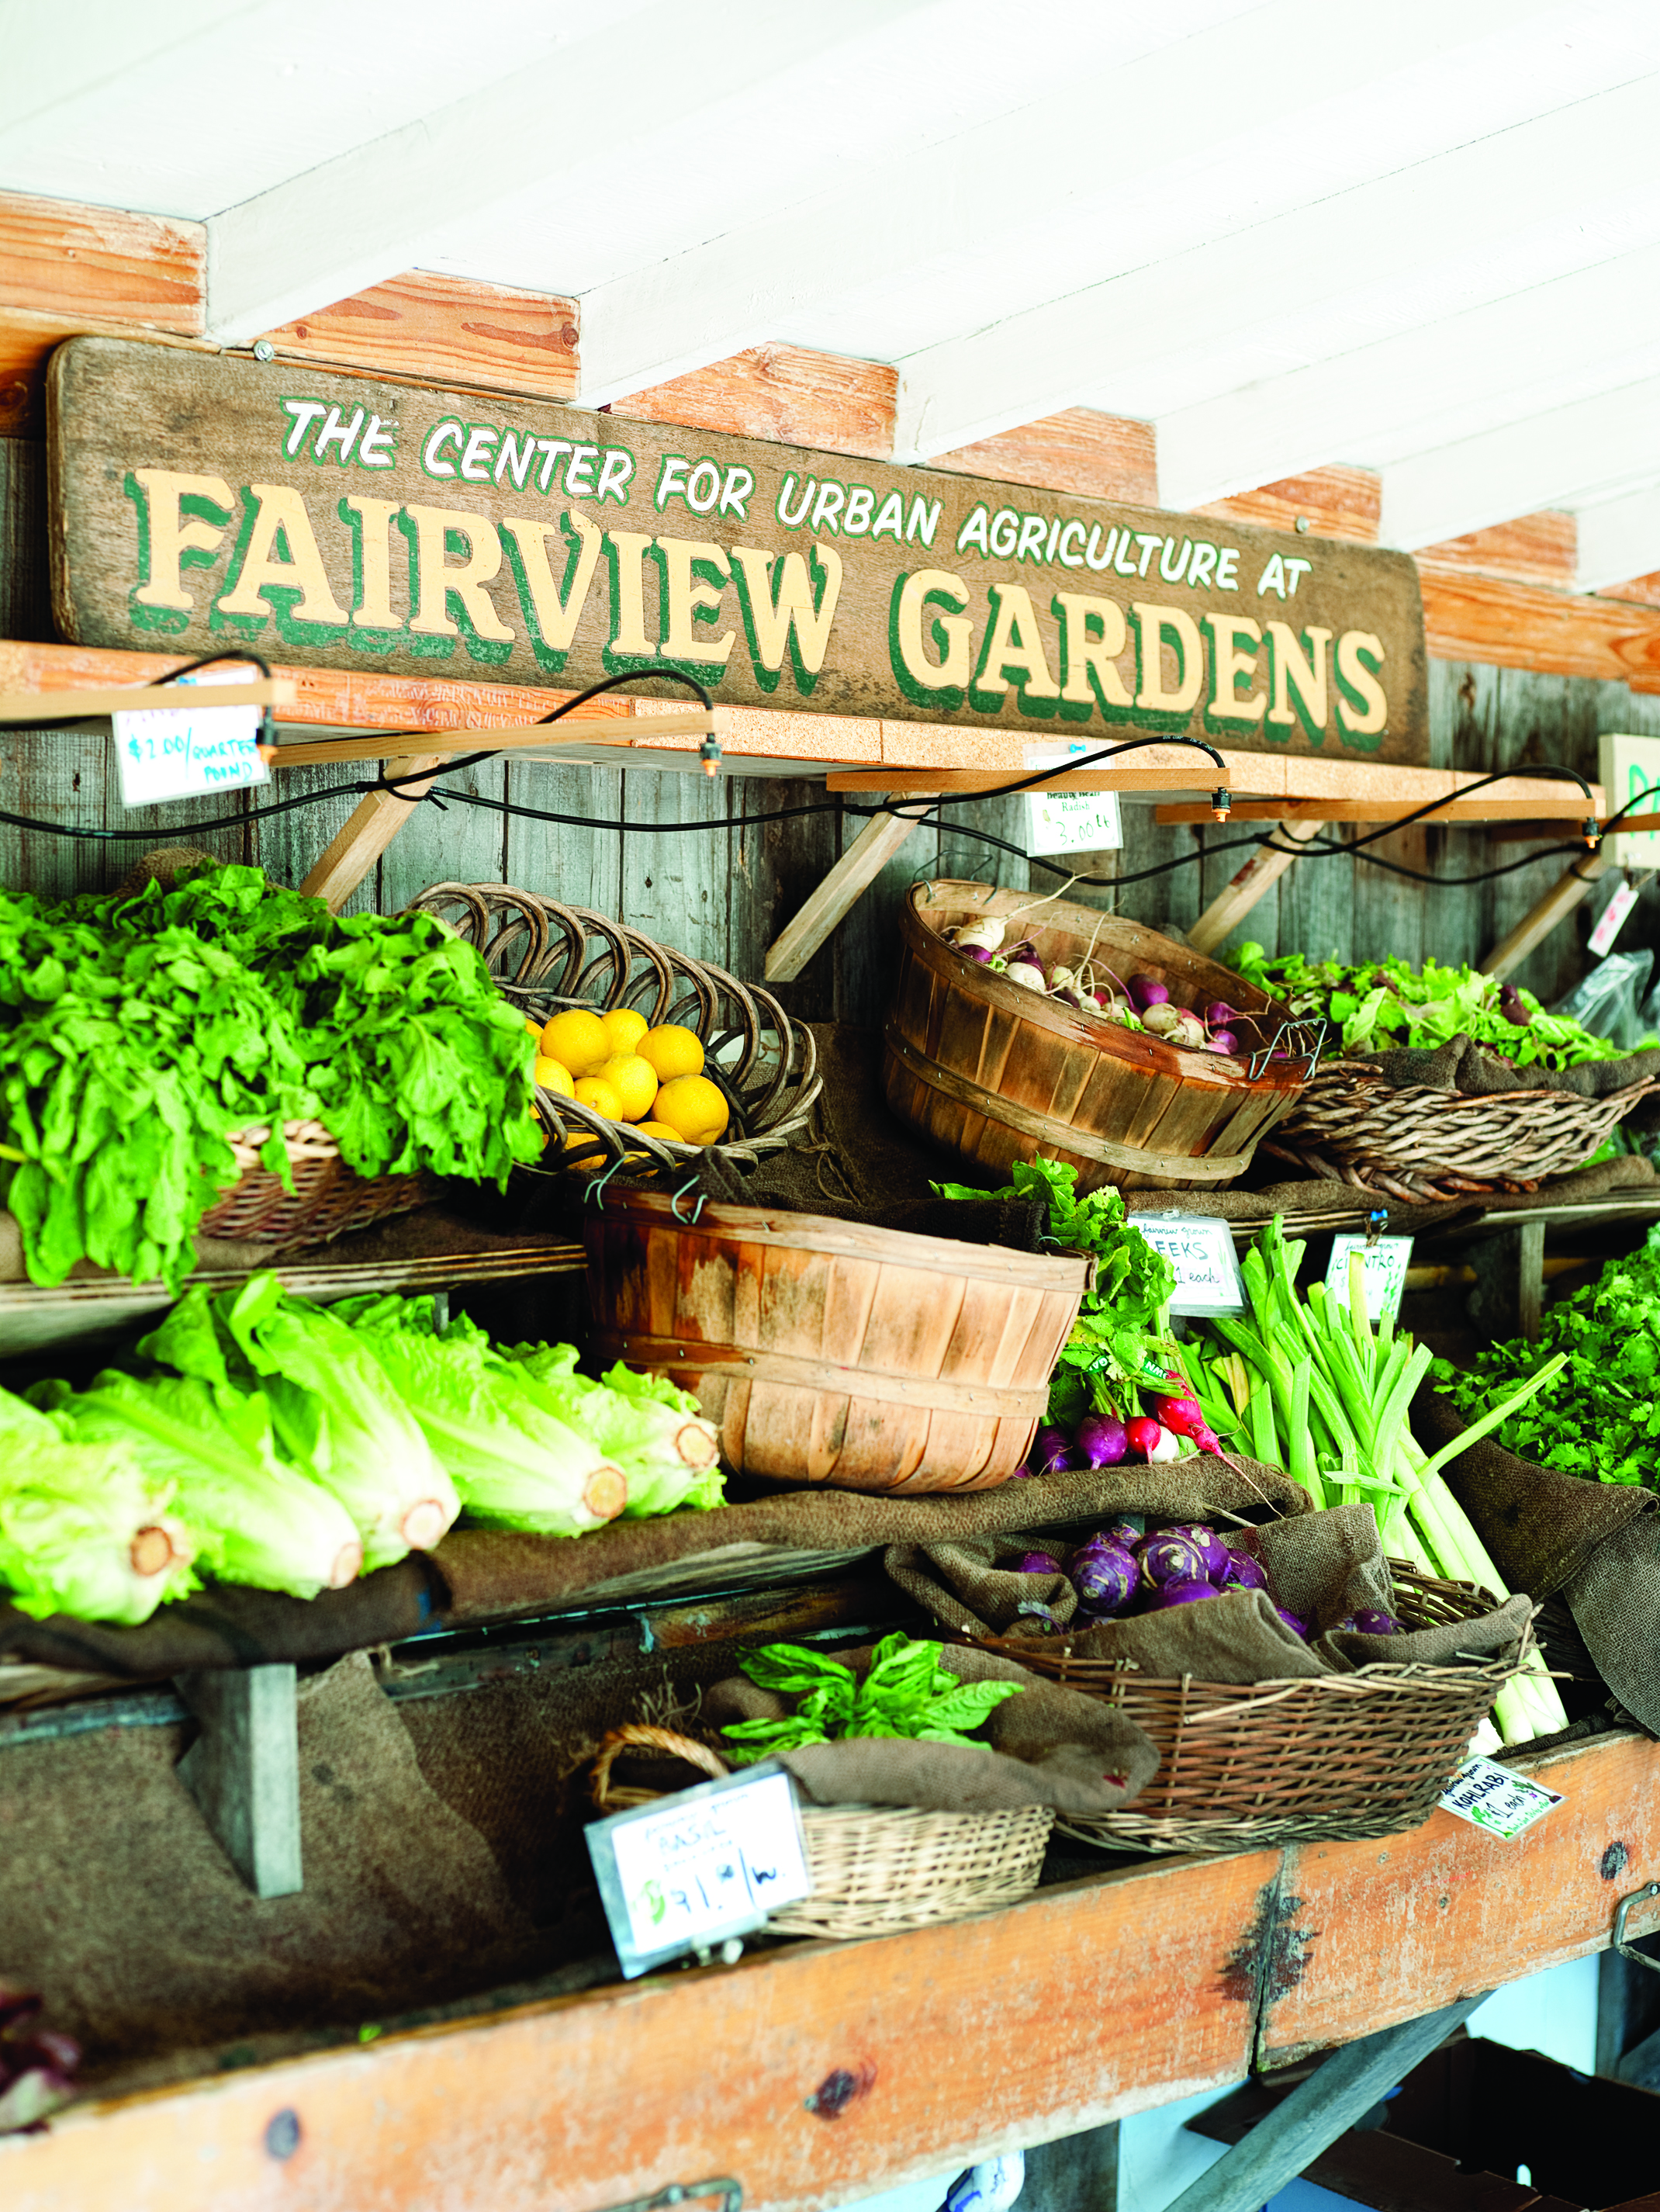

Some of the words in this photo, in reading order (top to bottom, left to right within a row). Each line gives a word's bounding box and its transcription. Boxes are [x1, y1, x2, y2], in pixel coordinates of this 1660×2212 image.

[284, 401, 400, 466] THE
[424, 423, 633, 500] CENTER
[657, 459, 753, 519] FOR
[778, 476, 942, 545] URBAN
[957, 506, 1241, 592] AGRICULTURE
[1257, 552, 1312, 600] AT
[132, 467, 845, 677] FAIRVIEW
[894, 568, 1389, 736] GARDENS
[203, 755, 253, 784] POUND
[1061, 801, 1091, 812] Radish
[1055, 821, 1094, 846] 3.00
[1141, 1223, 1178, 1238] fairview
[1181, 1227, 1213, 1239] grown
[1154, 1241, 1209, 1260] EEKS
[1336, 1255, 1395, 1272] CINTRO
[1189, 1267, 1220, 1284] each
[1451, 1772, 1510, 1810] KOHLRABI
[1504, 1793, 1527, 1810] each
[659, 1820, 726, 1856] BASIL
